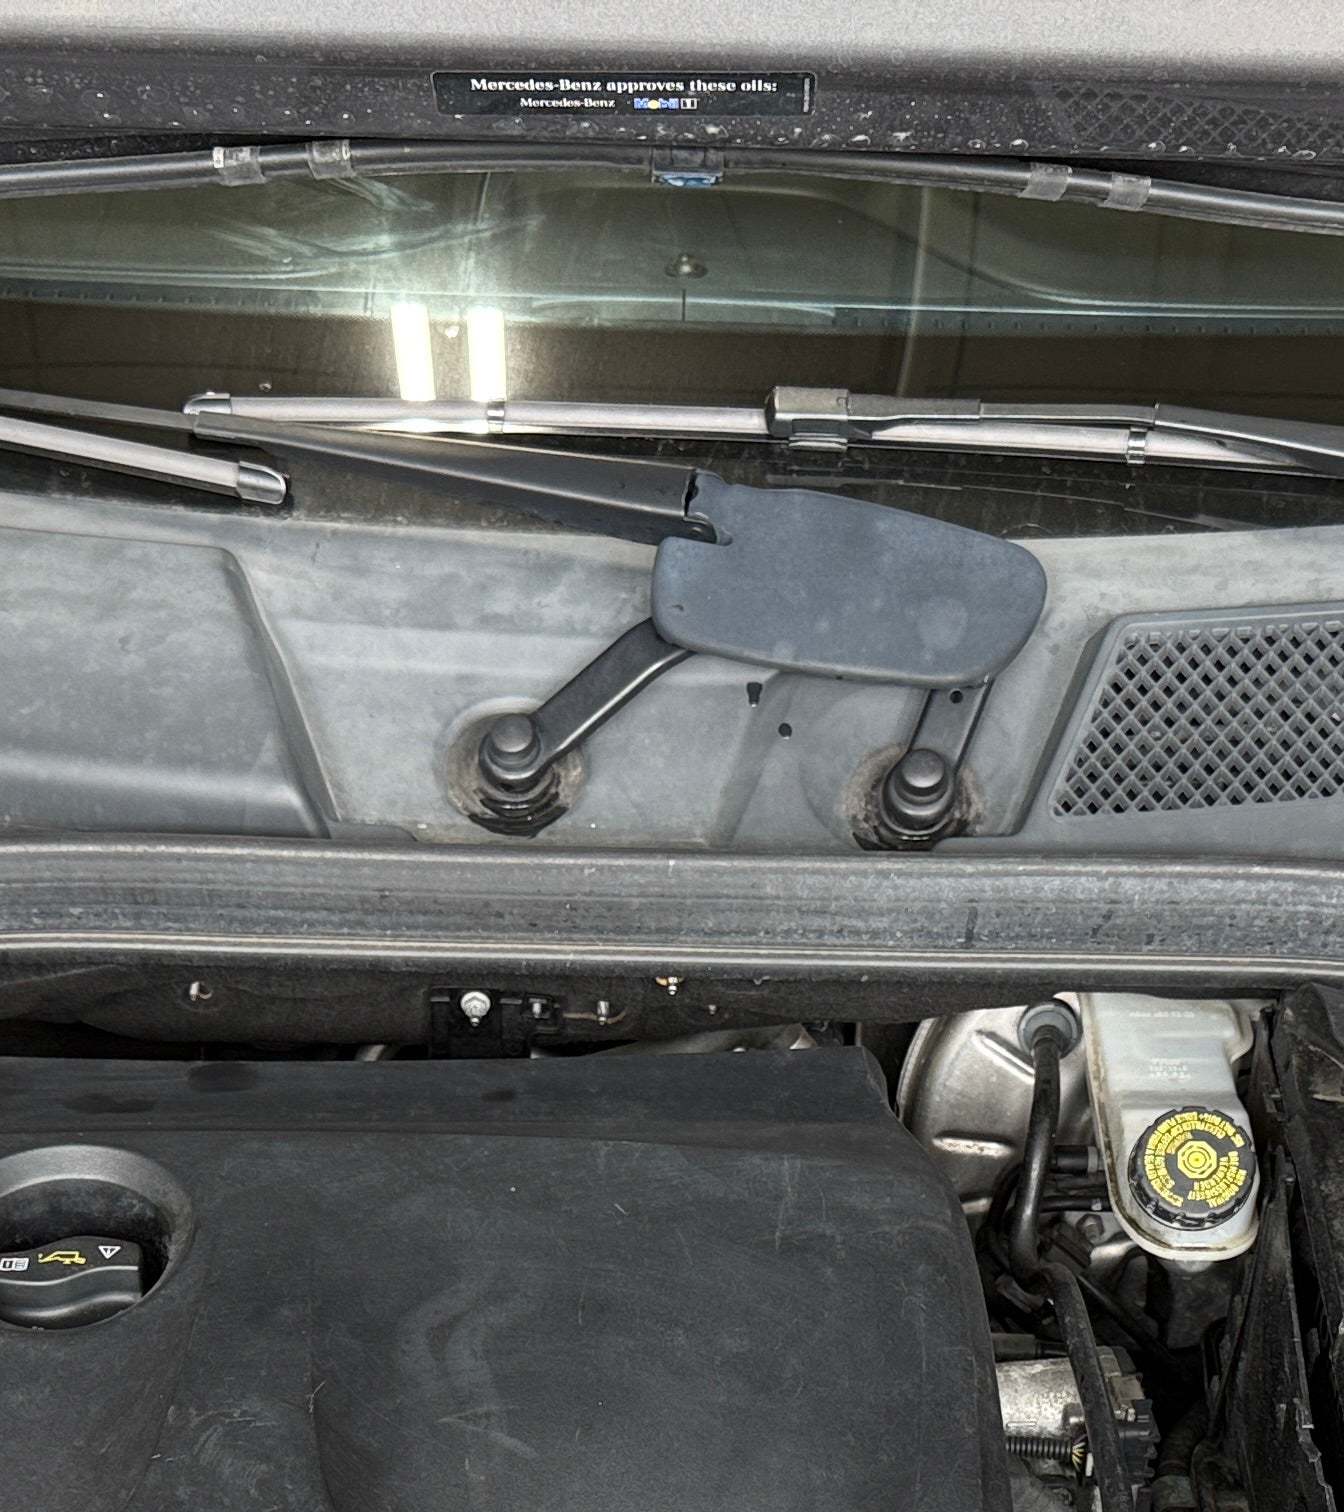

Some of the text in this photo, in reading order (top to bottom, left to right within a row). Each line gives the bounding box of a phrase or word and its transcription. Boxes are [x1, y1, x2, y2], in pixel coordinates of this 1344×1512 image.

[470, 78, 778, 94] Mercedes-Benz approves these oils:
[520, 97, 616, 108] Mercedes-Benz
